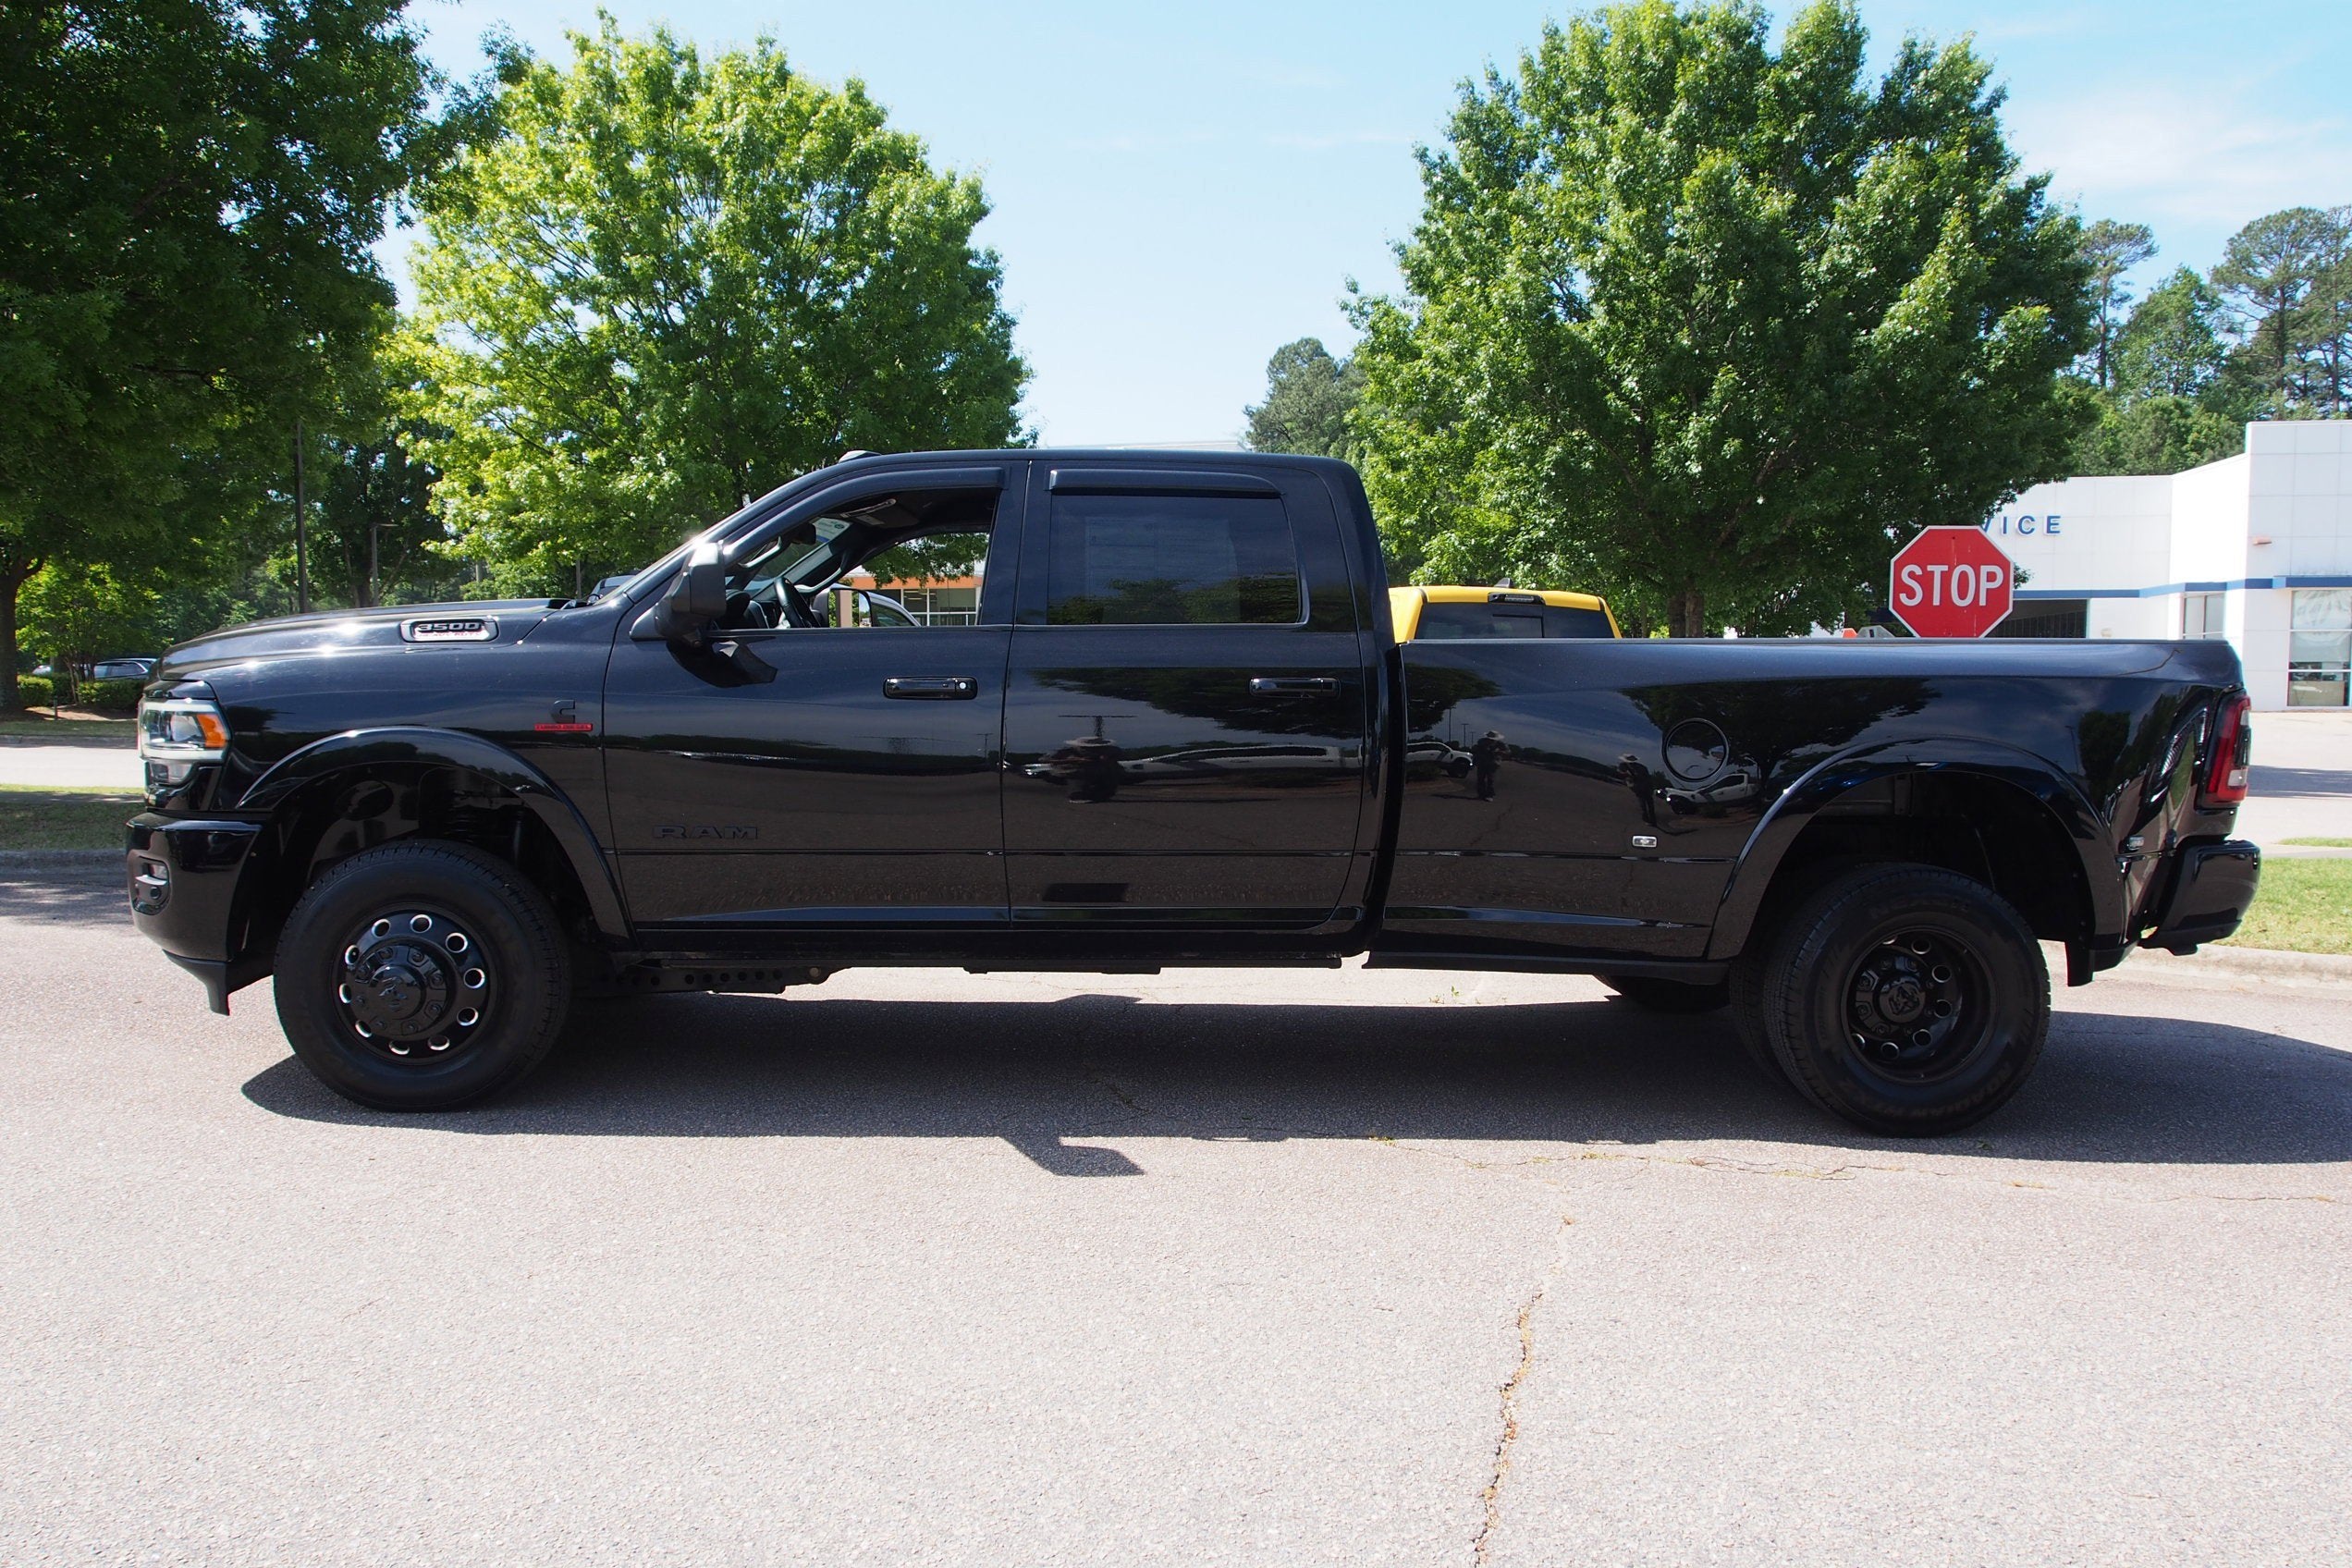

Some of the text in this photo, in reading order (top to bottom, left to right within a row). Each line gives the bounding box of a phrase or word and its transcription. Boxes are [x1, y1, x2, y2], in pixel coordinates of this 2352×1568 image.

[1899, 564, 2004, 606] STOP
[418, 622, 481, 631] 3500
[653, 825, 758, 839] RAM
